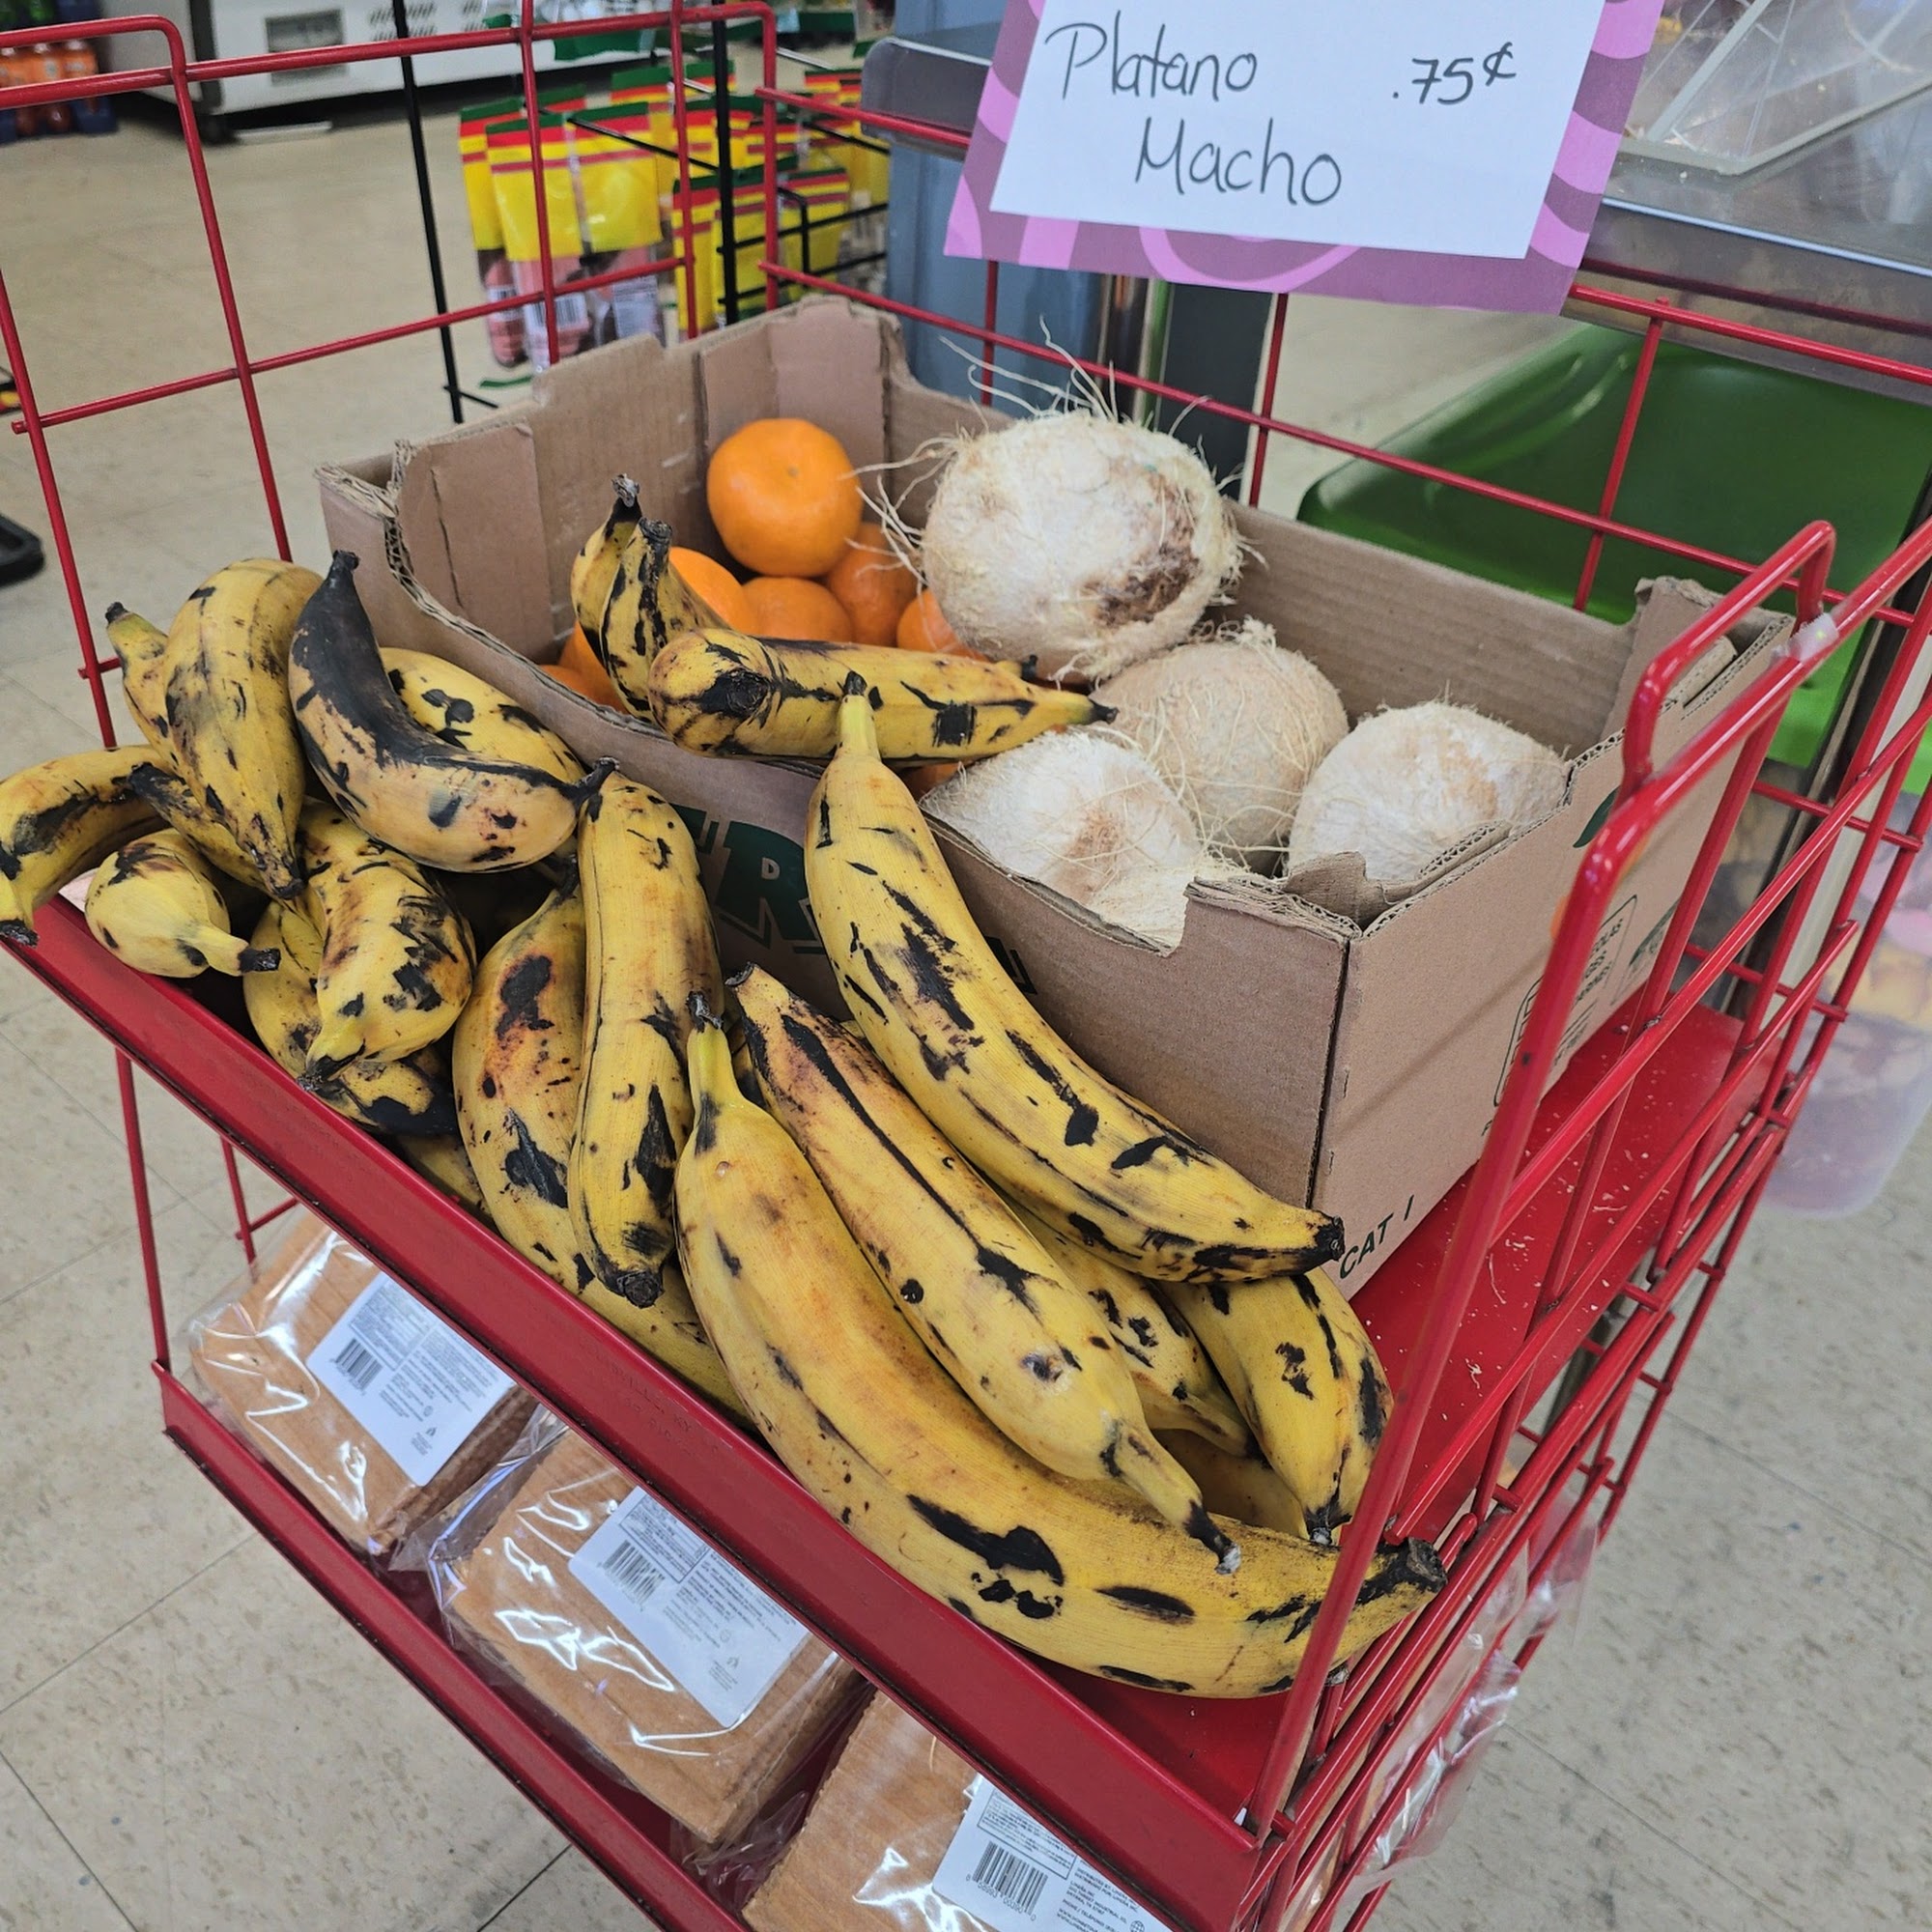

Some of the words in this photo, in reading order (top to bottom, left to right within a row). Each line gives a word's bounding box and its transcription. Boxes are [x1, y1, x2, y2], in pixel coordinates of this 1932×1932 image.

[1044, 10, 1258, 99] Platano
[1134, 117, 1342, 205] Macho
[1340, 1212, 1394, 1279] CAT
